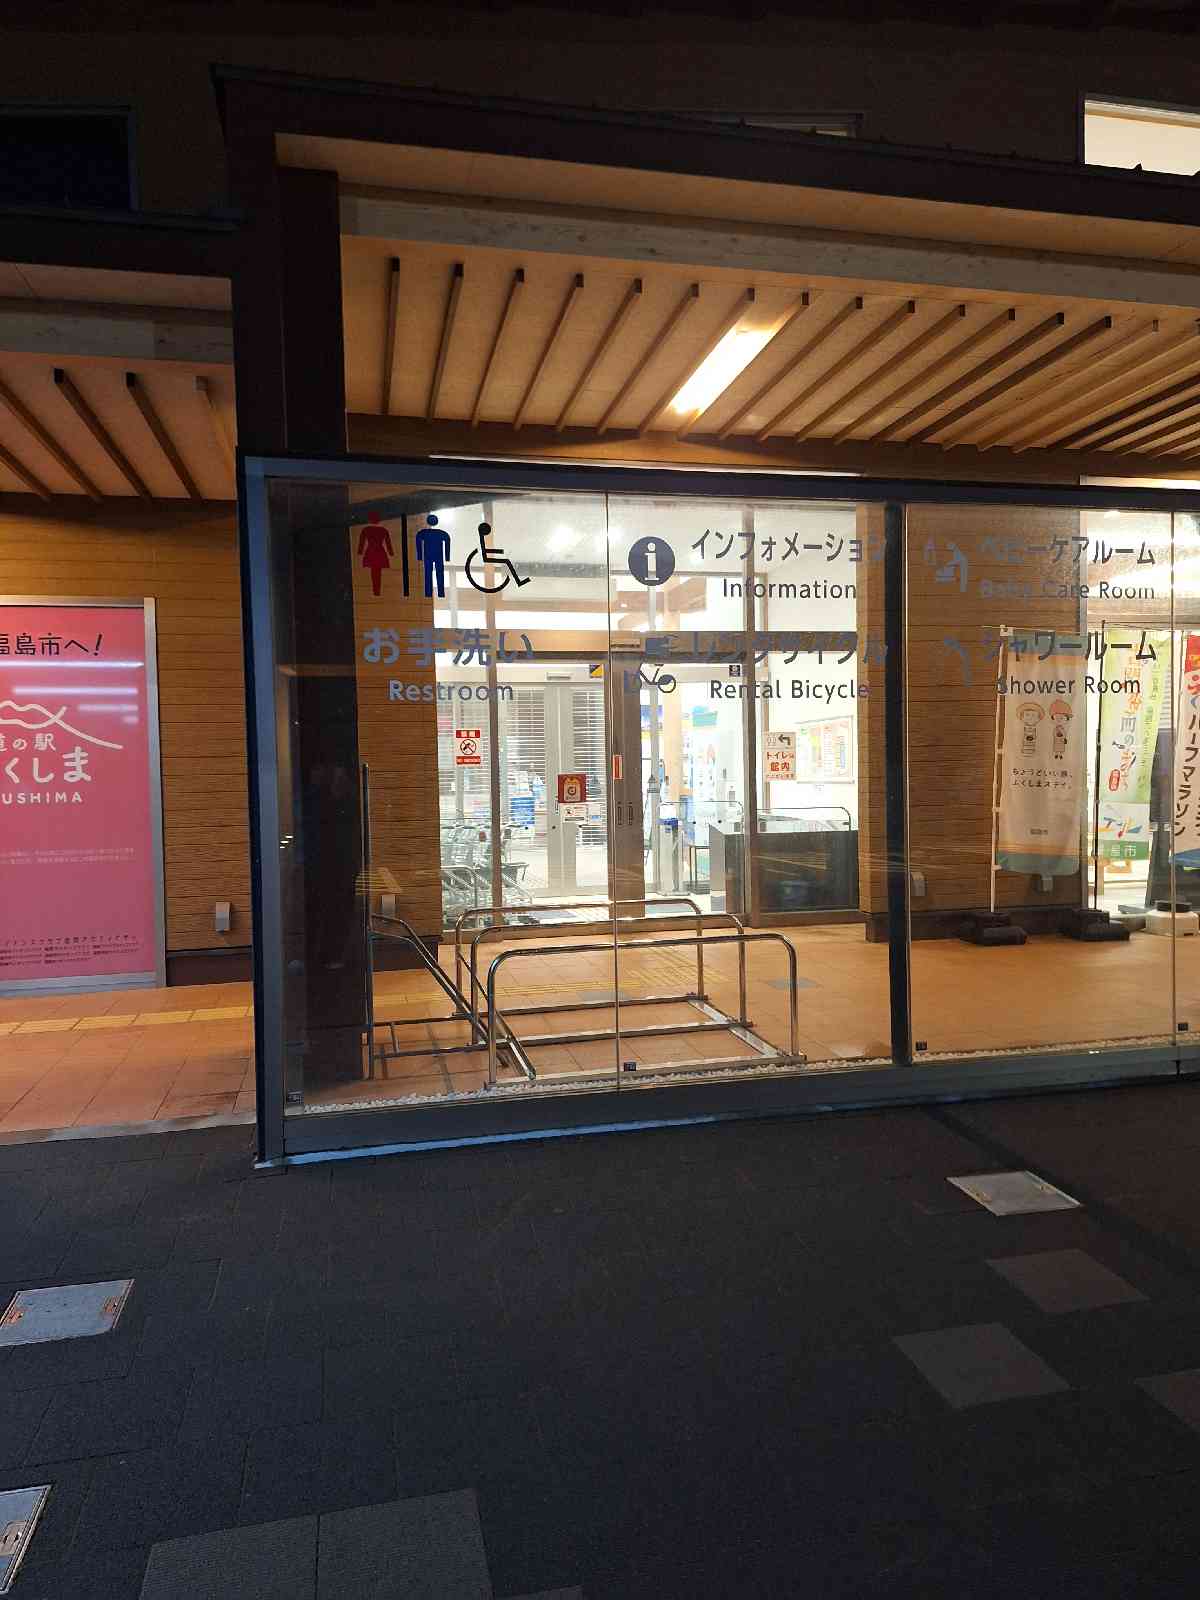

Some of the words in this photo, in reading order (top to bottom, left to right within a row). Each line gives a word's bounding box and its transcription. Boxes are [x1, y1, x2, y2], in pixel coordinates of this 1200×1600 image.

[723, 578, 856, 599] Information
[1099, 581, 1155, 599] Room
[363, 627, 535, 667] お手洗い
[980, 631, 1156, 661] シャワールーム
[389, 680, 514, 701] Restroom
[710, 680, 781, 699] Rental
[791, 680, 869, 705] Bicycle
[995, 675, 1075, 695] Shower
[1084, 676, 1141, 695] Room
